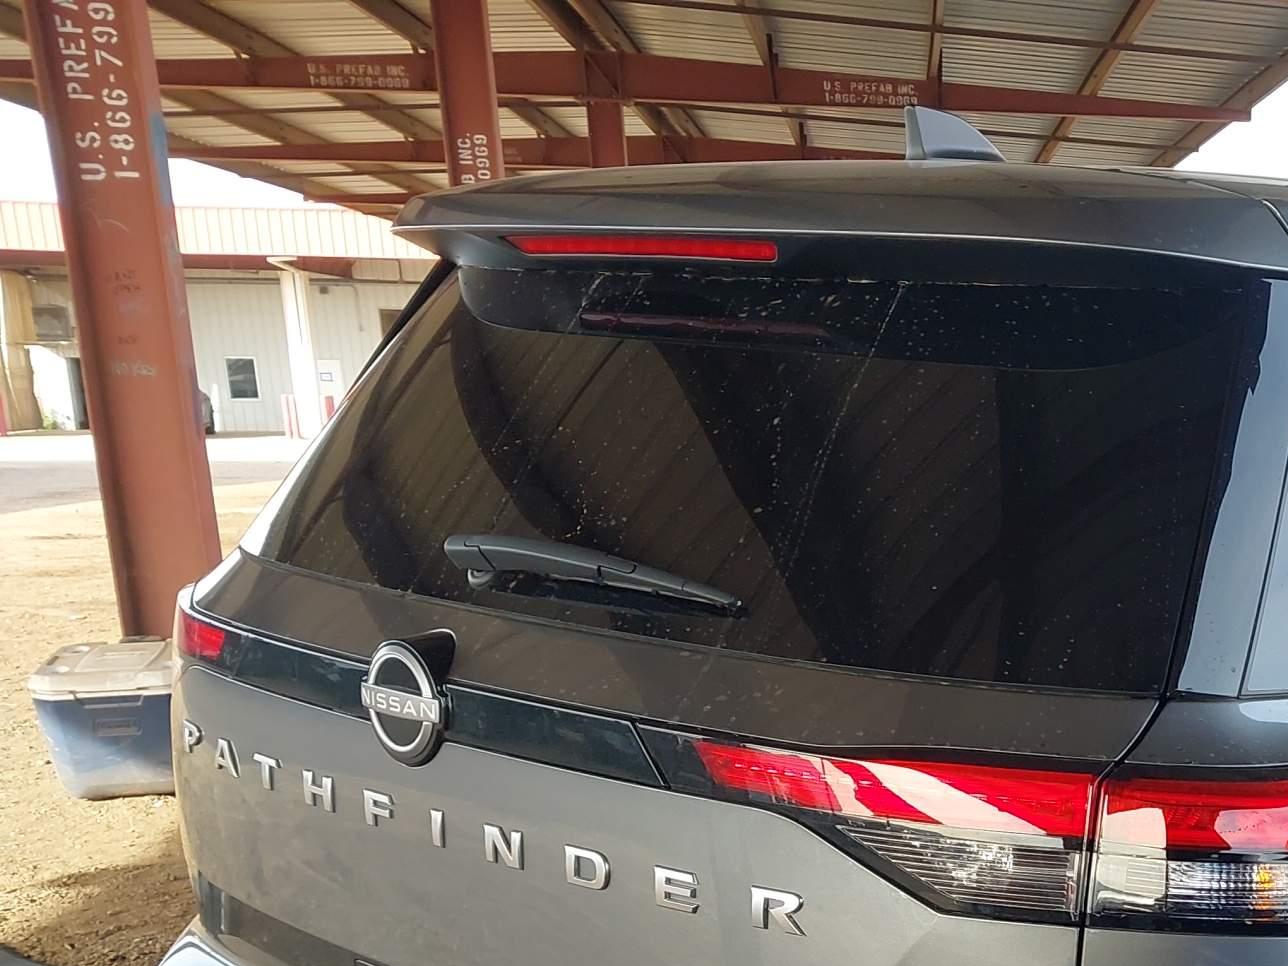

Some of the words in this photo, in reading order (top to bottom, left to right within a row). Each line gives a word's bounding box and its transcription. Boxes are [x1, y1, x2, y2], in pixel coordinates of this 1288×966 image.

[336, 64, 382, 75] PREFAB
[850, 82, 893, 94] PREFAB
[898, 84, 919, 96] INC.
[75, 121, 107, 181] U.S.
[457, 133, 473, 165] INC.
[361, 684, 436, 720] NISSAN
[183, 718, 808, 937] PATHFINDER
